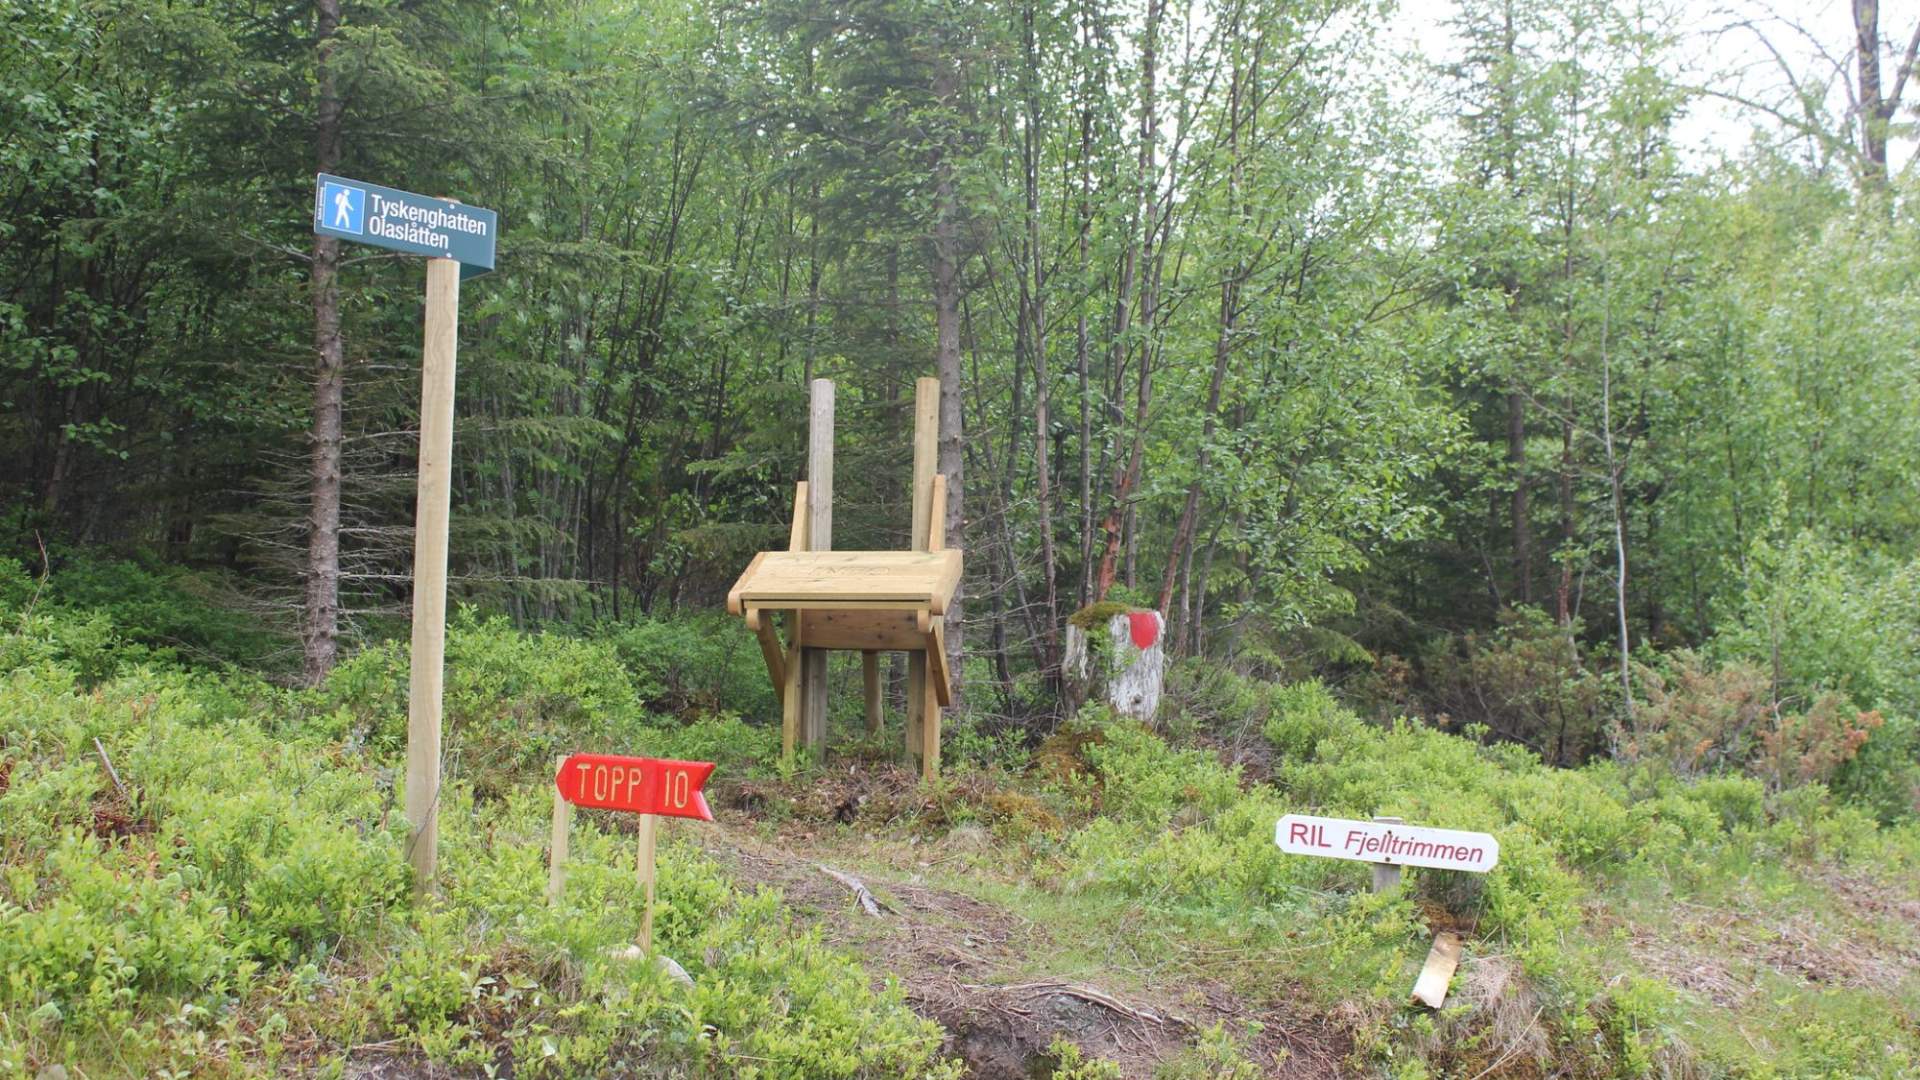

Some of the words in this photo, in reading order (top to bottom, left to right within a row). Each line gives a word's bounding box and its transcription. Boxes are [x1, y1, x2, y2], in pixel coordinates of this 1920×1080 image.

[369, 216, 449, 249] Olaslåtten
[371, 193, 487, 236] Tyskenghatten
[576, 763, 642, 804] TOPP
[664, 769, 689, 809] 10
[1289, 823, 1331, 848] RIL
[1343, 830, 1484, 864] Fjelltrimmen
